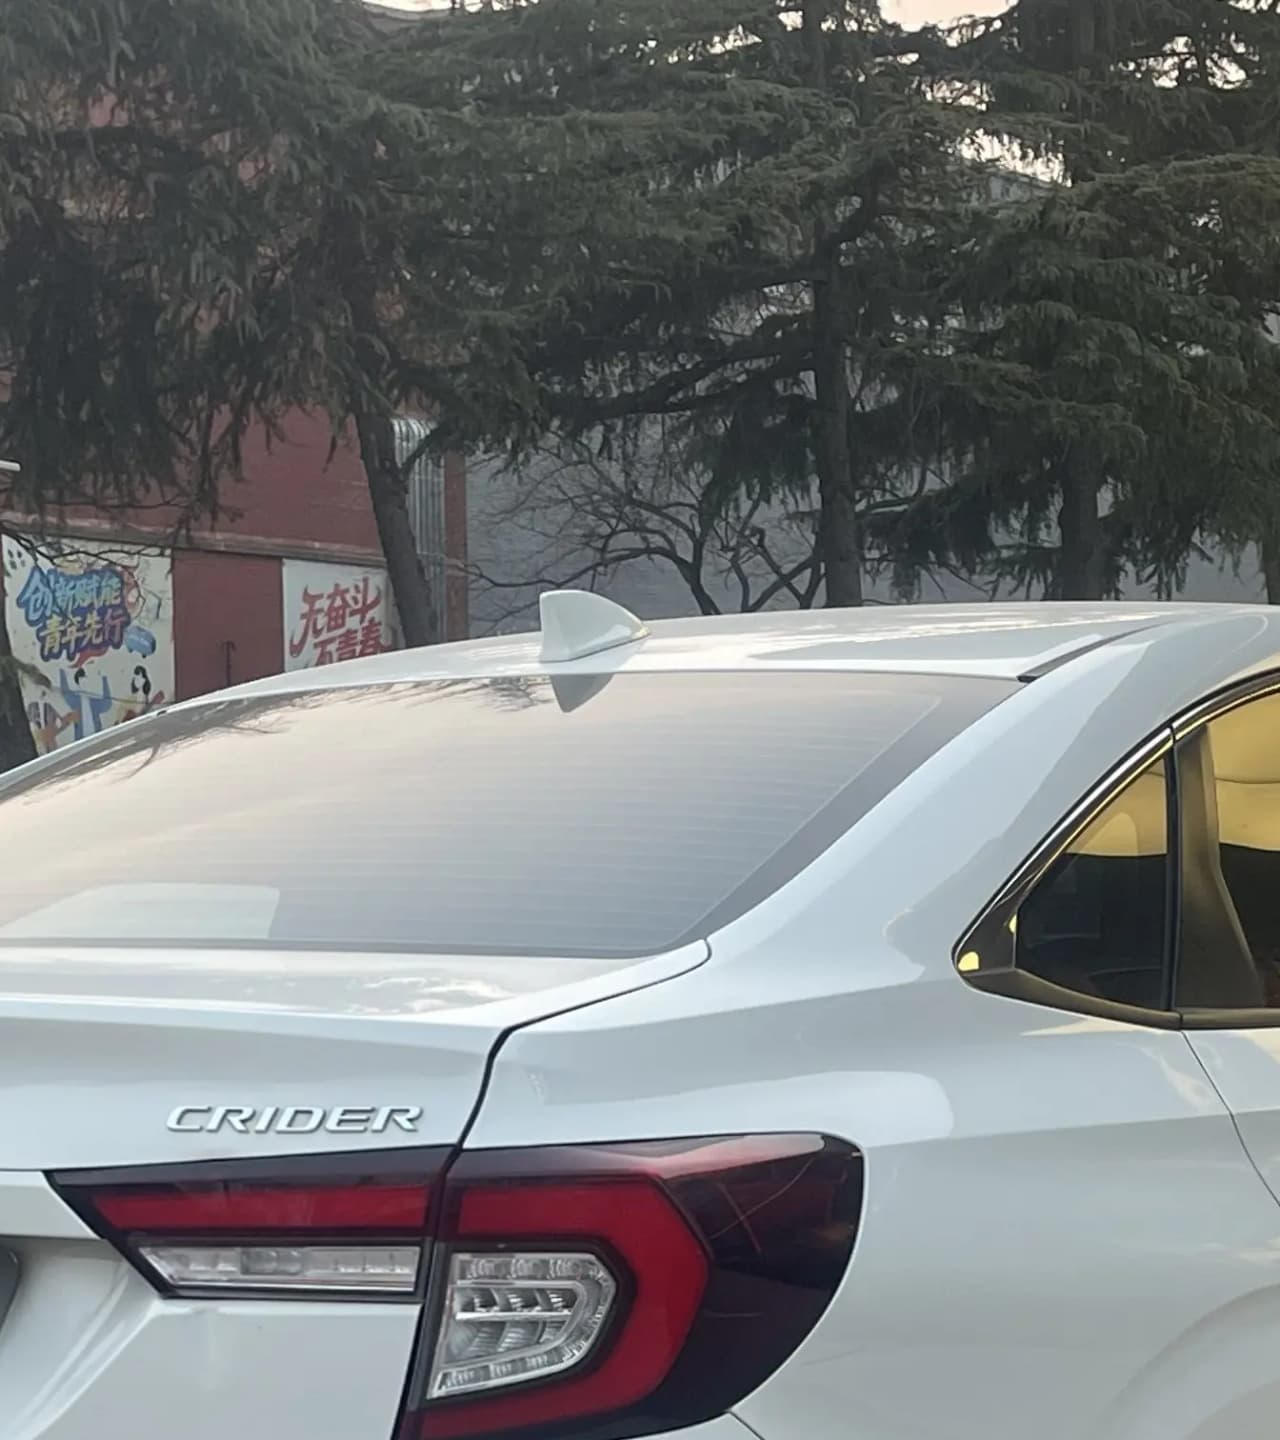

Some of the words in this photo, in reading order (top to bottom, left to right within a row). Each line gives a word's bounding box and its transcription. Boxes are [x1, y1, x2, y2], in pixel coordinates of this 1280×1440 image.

[39, 609, 128, 657] 青年先行
[166, 1105, 423, 1134] CRIDER
